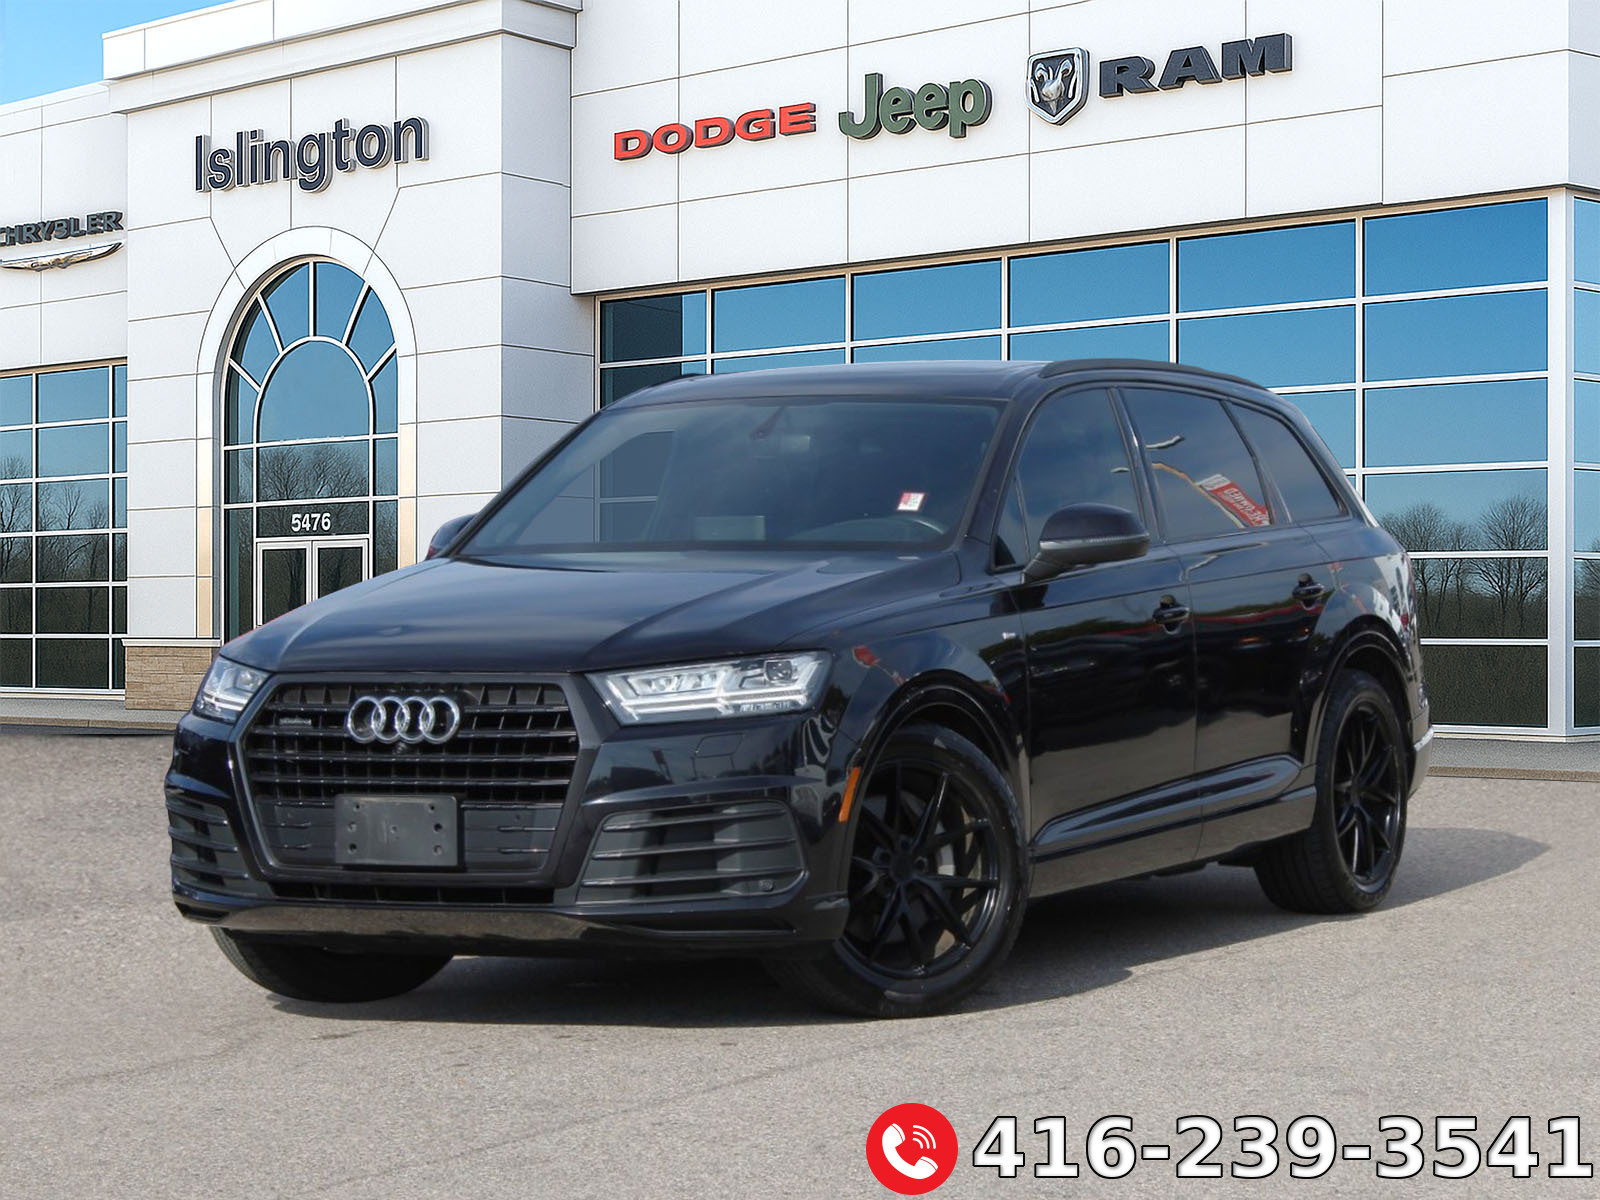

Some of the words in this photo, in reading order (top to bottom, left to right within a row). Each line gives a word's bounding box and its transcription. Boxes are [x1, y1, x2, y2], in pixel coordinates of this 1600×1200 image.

[1099, 33, 1293, 97] RAM
[613, 102, 817, 161] DODGE
[838, 73, 992, 140] Jeep
[195, 115, 430, 193] Islington
[291, 512, 331, 532] 5476
